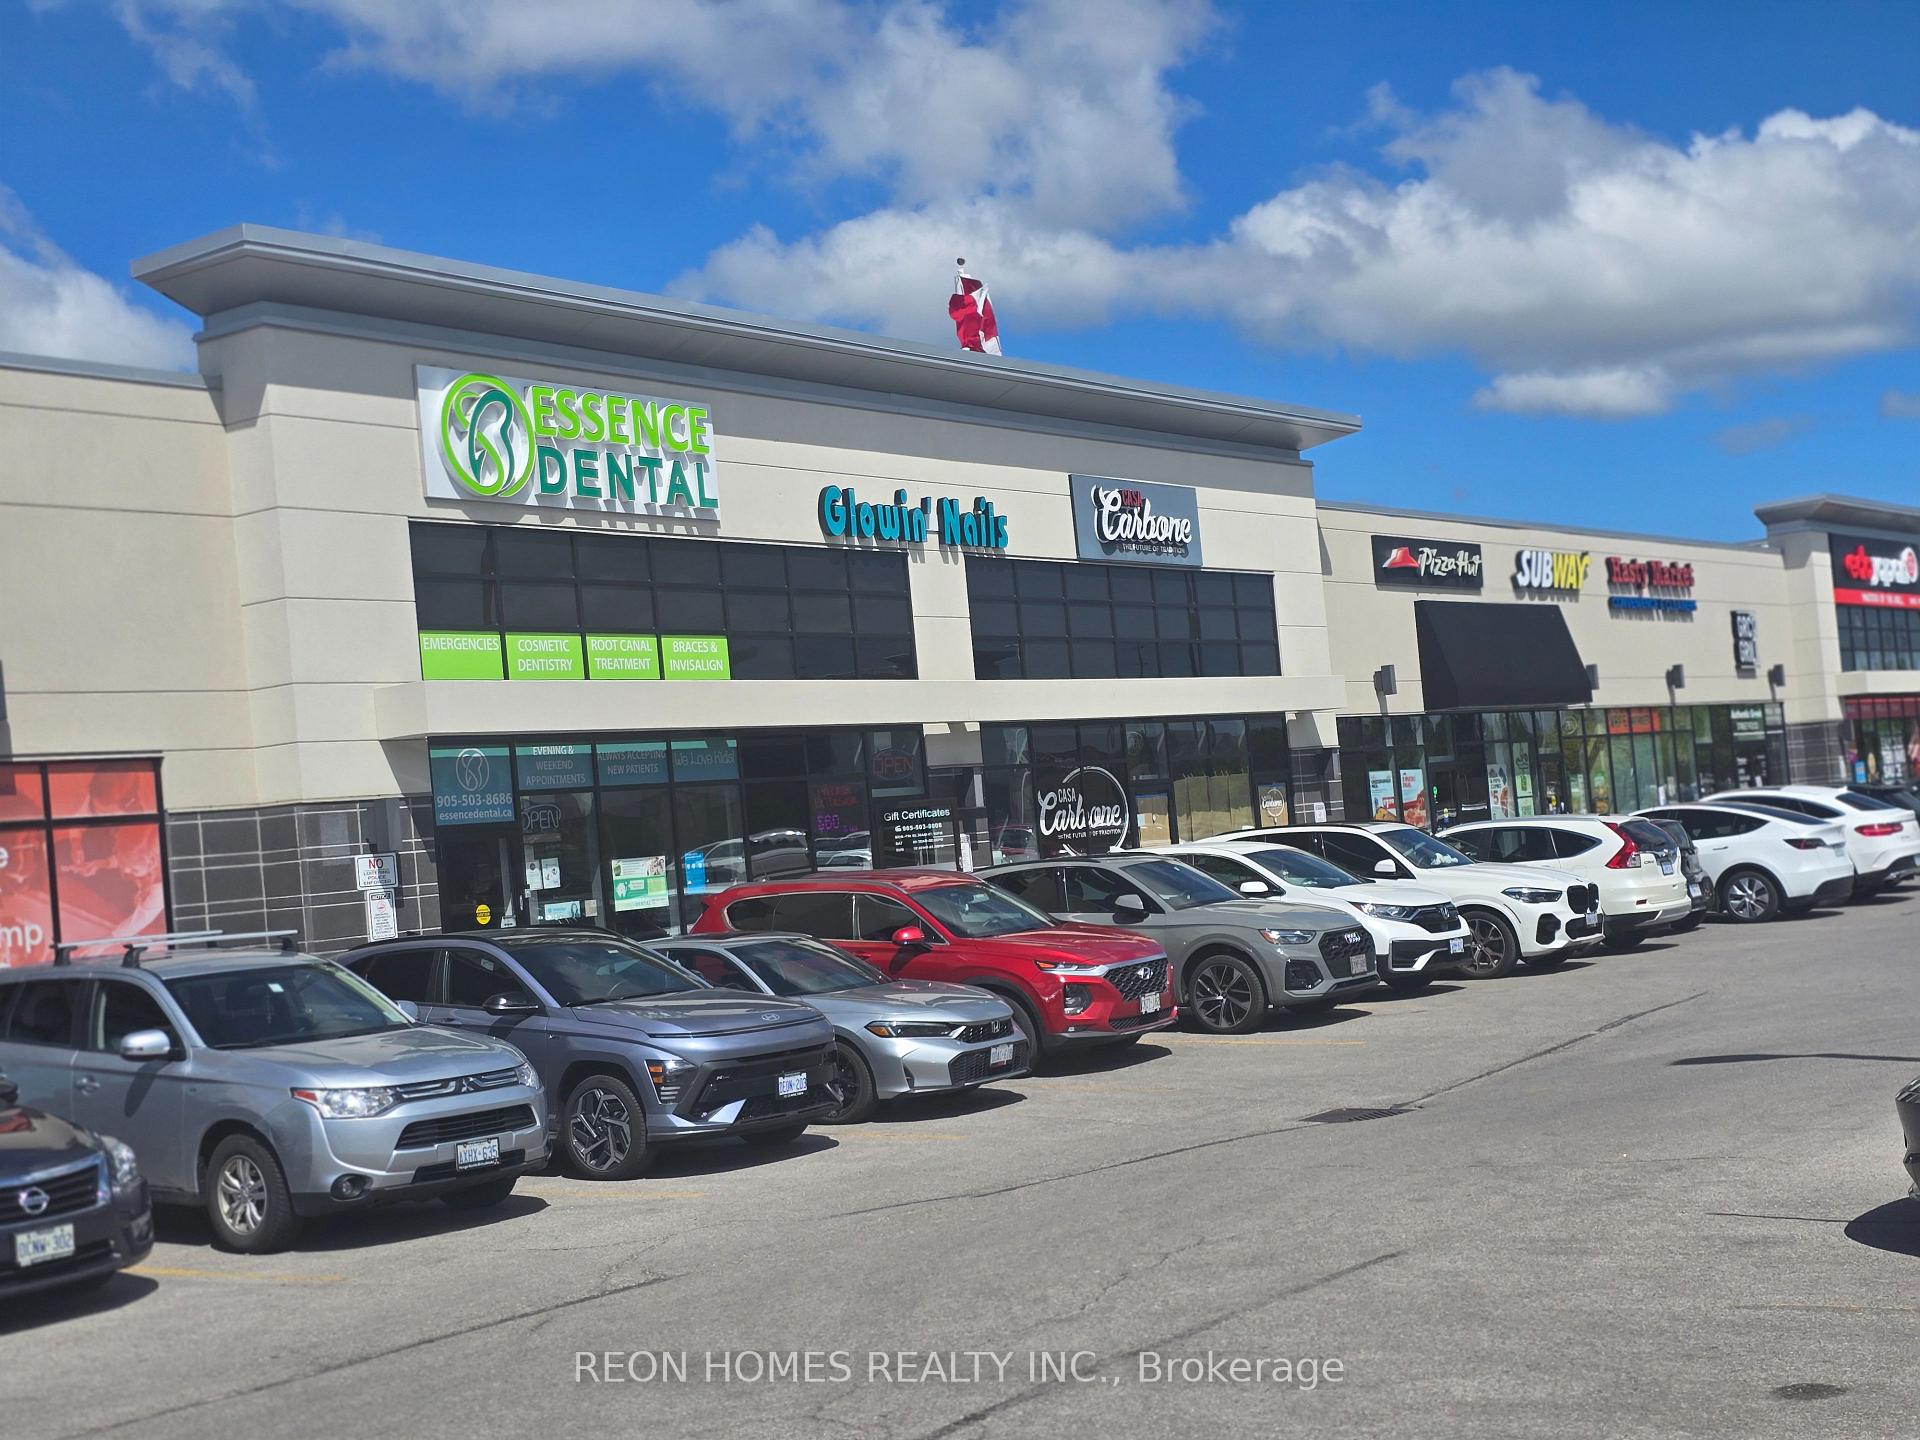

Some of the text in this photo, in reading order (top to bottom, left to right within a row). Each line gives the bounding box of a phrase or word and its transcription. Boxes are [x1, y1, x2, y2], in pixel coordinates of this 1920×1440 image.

[529, 386, 710, 454] ESSENCE
[535, 445, 719, 509] DENTAL
[1121, 489, 1143, 507] CASA
[819, 484, 1008, 549] Glowin' Nails
[1092, 485, 1192, 543] Carbone
[1418, 547, 1482, 577] Pizza Hut
[1512, 550, 1592, 589] SUBWAY
[1606, 556, 1695, 588] Hasty Market
[423, 637, 500, 651] EMERGENCIES
[518, 639, 569, 652] COSMETIC
[591, 639, 652, 652] ROOT CANAL
[672, 641, 718, 653] BRACES &
[518, 658, 573, 671] DENTISTRY
[595, 657, 651, 670] TREATMENT
[669, 658, 724, 671] INVISALIGN
[532, 745, 575, 756] EVENING &
[597, 750, 666, 761] ALWAYS ACCEPTING
[535, 759, 574, 770] WEEKEND
[607, 763, 659, 775] NEW PATIENTS
[873, 757, 914, 777] OPEN
[526, 773, 586, 786] APPOINTMENTS
[437, 793, 513, 808] 905-503-8686
[1058, 788, 1077, 803] CASA
[439, 808, 513, 821] essencedental.ca
[521, 809, 560, 831] OPEN
[883, 808, 951, 822] Gift Certificates
[1038, 790, 1122, 836] Carbone
[368, 858, 384, 869] NO
[482, 1144, 498, 1160] 635
